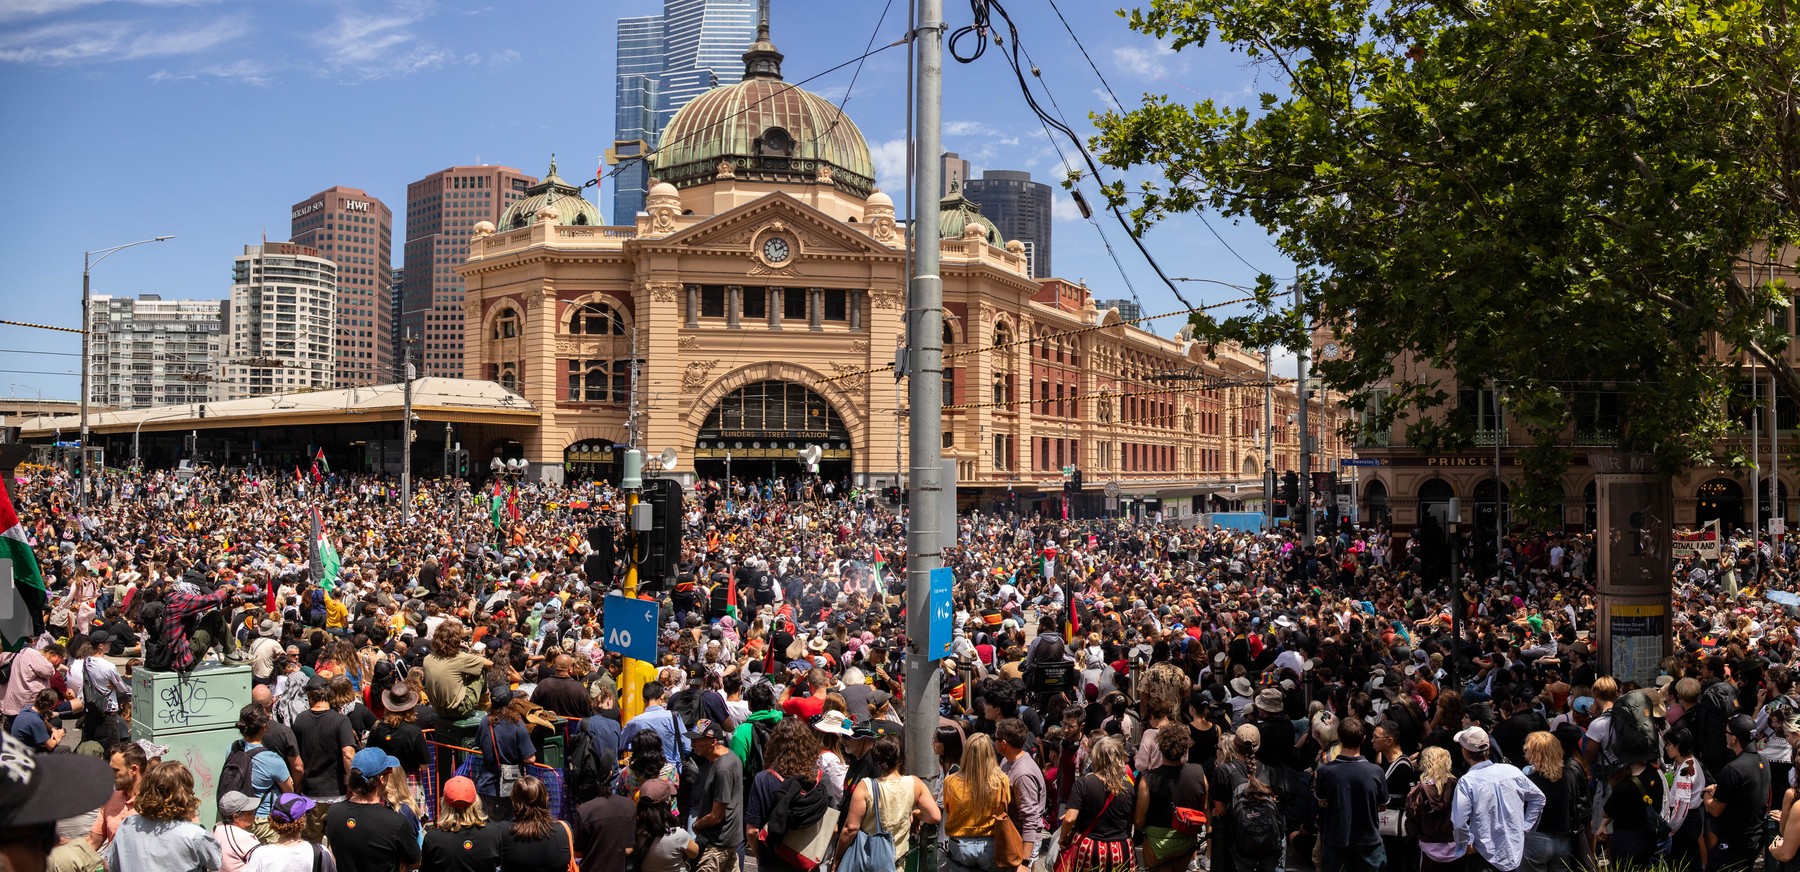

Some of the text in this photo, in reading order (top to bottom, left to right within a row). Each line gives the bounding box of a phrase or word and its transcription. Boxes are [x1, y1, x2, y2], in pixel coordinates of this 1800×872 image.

[292, 201, 324, 219] HERALD SUN
[346, 200, 369, 211] HWT
[609, 628, 631, 648] AO
